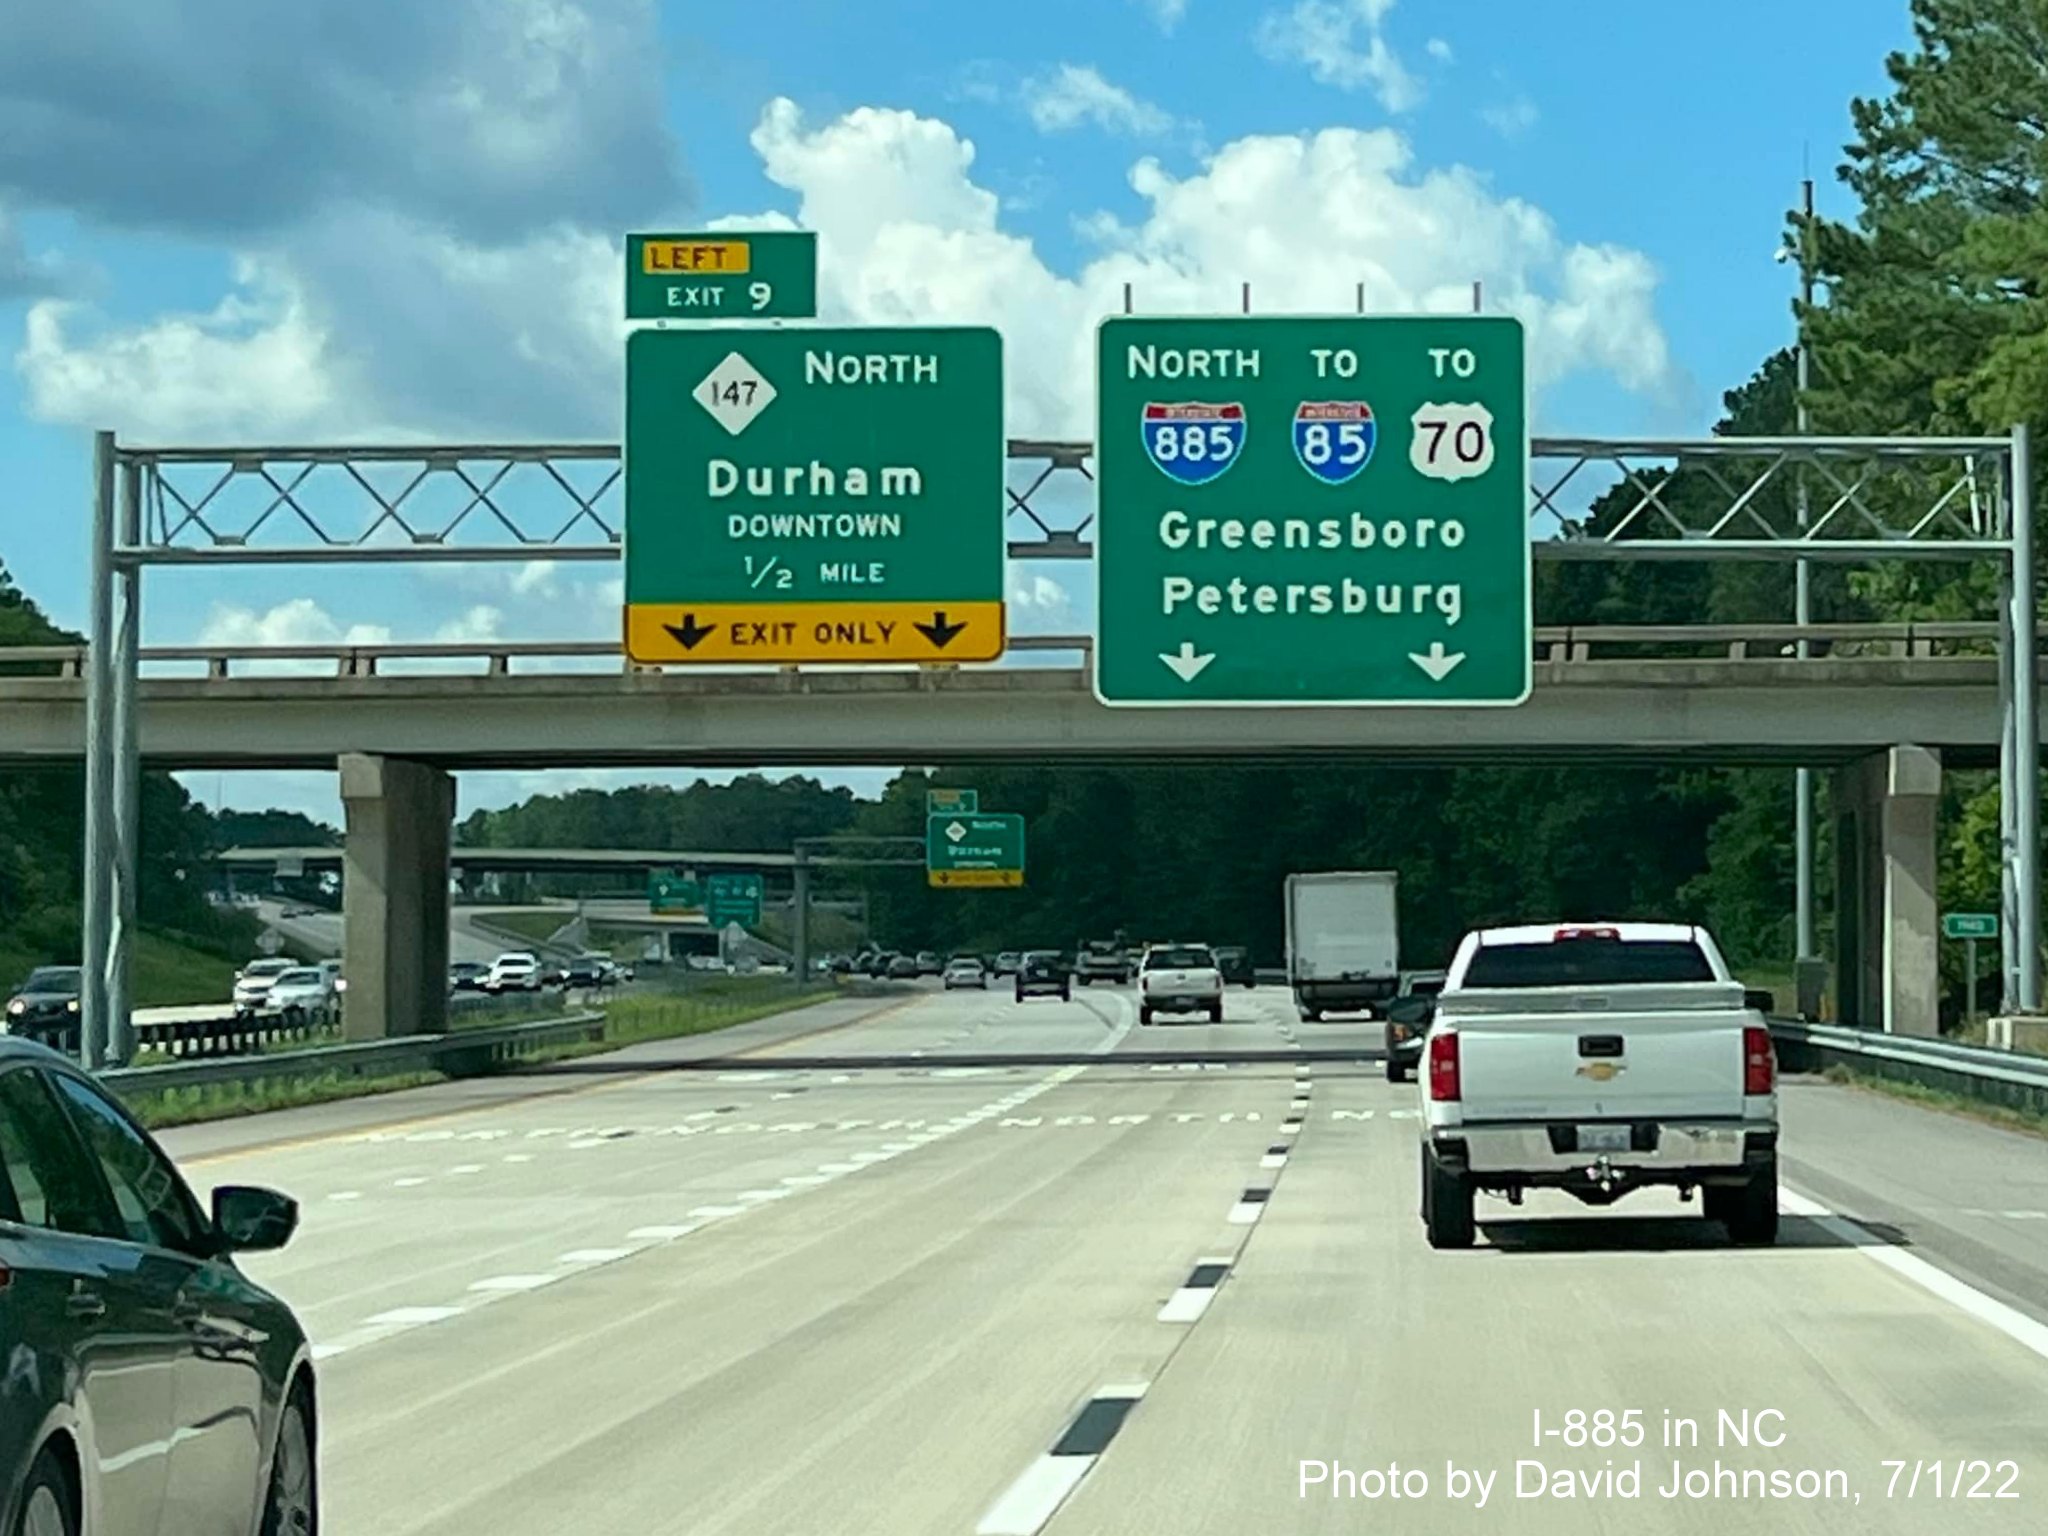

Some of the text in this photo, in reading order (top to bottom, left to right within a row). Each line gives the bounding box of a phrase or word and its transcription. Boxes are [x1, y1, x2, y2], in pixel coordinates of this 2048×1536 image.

[651, 246, 728, 270] LEFT
[667, 282, 772, 311] EXIT 9
[805, 350, 938, 384] NORTH
[1128, 345, 1260, 379] NORTH
[1311, 349, 1358, 378] TO
[1428, 348, 1477, 378] TO
[710, 380, 758, 407] 147
[1154, 425, 1234, 462] 885
[1303, 423, 1367, 466] 85
[1418, 420, 1486, 464] 70
[708, 459, 922, 498] Durham
[728, 514, 901, 538] DOWNTOWN
[1159, 511, 1466, 549] Greensboro
[743, 556, 886, 589] 1/2 MILE
[1162, 577, 1462, 626] Petersburg
[730, 621, 897, 645] EXIT ONLY
